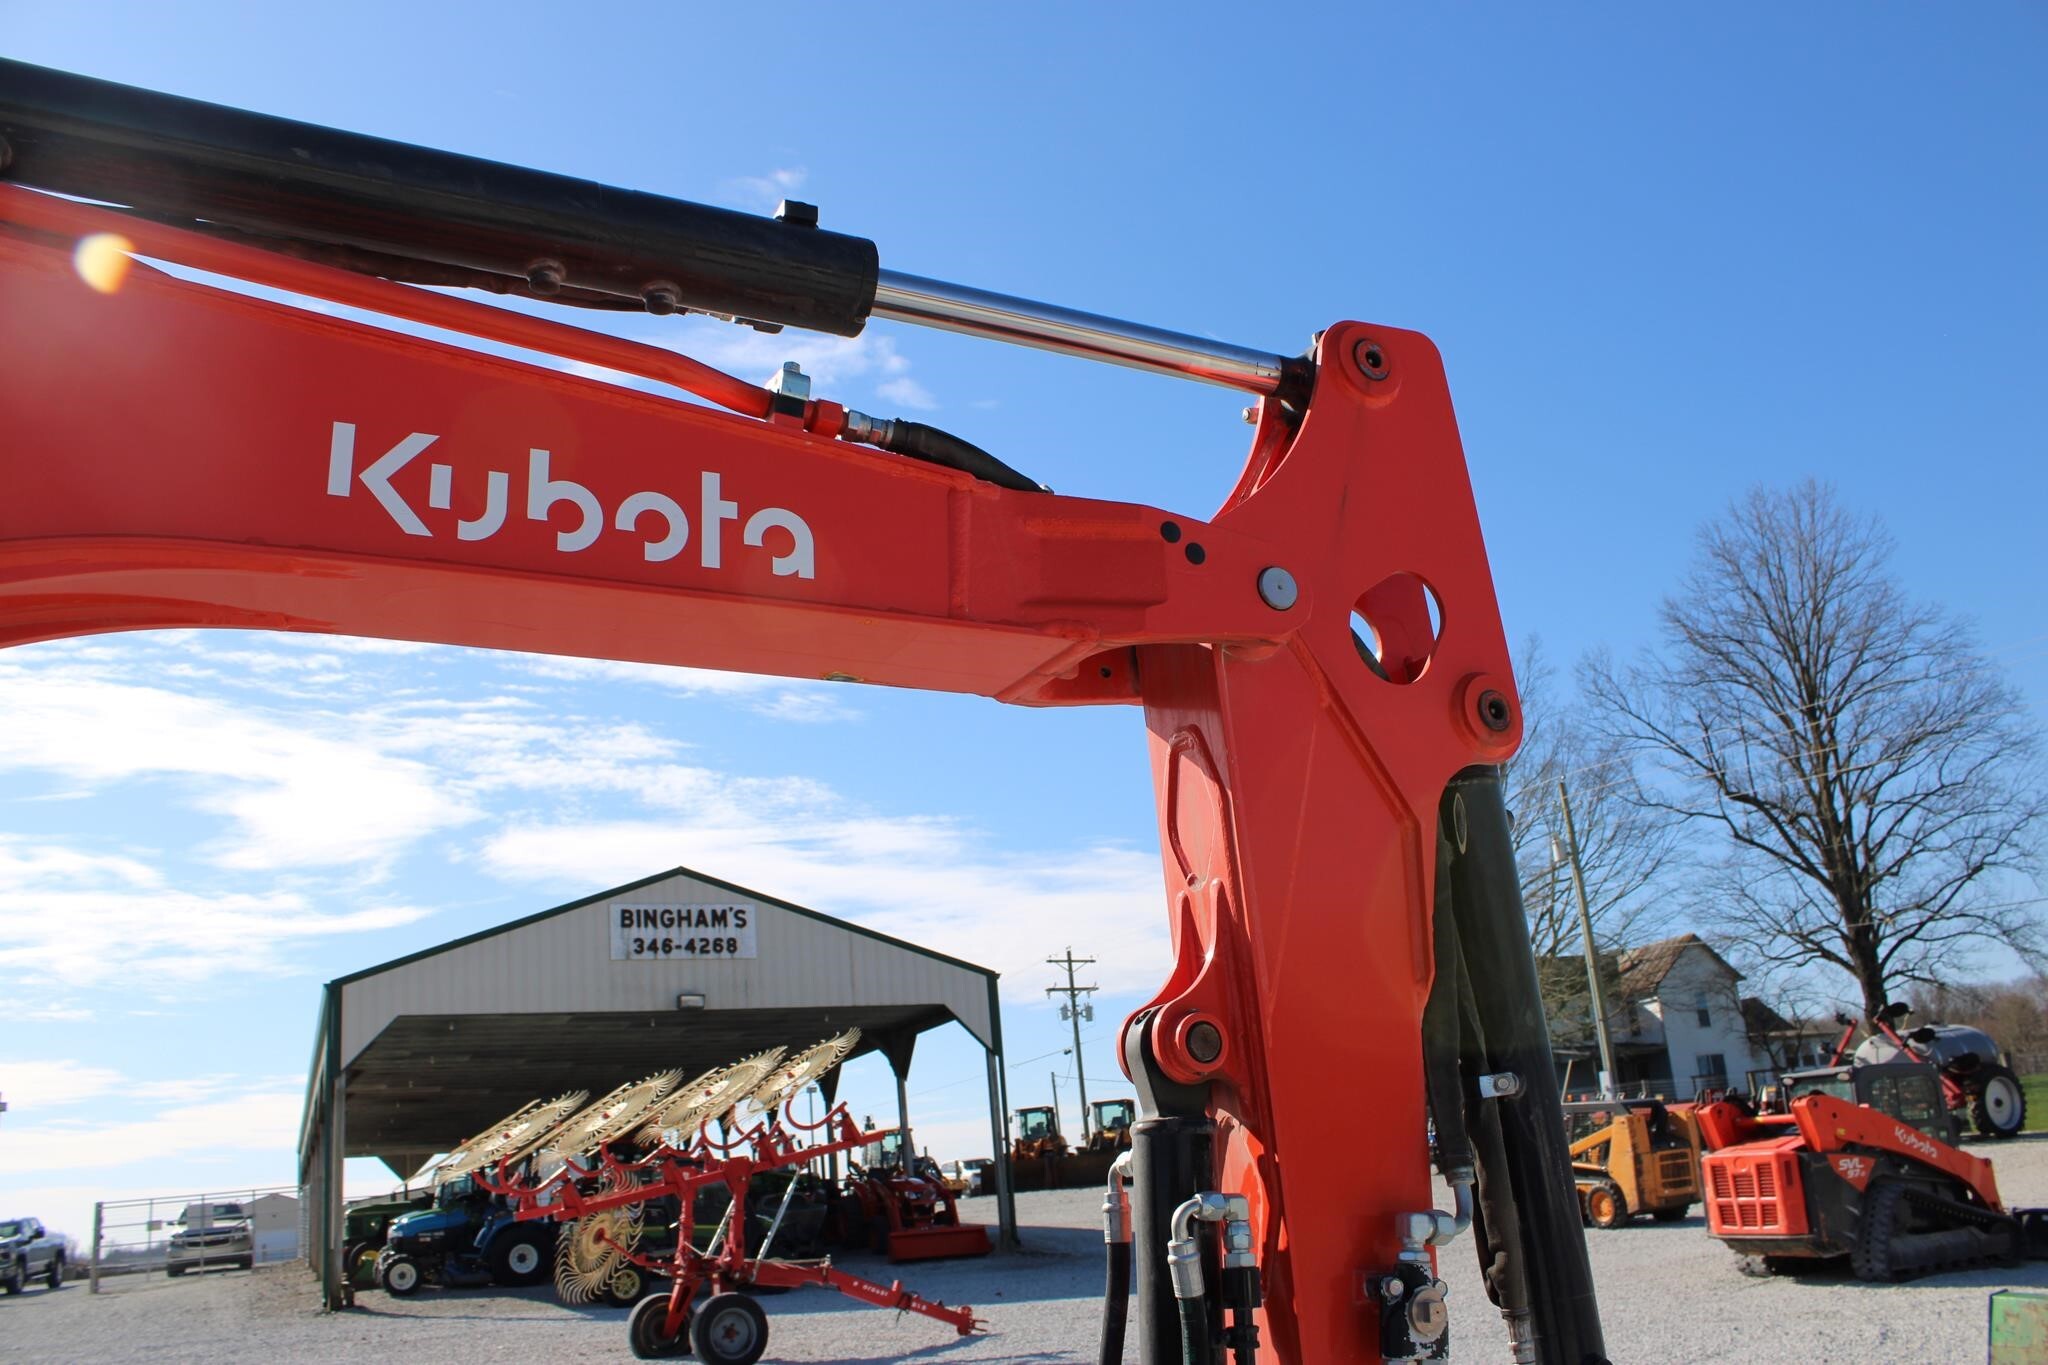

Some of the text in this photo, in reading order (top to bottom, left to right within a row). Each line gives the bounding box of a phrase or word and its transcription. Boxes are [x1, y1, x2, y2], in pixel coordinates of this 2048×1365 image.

[326, 420, 816, 580] Kubota
[620, 907, 748, 929] BINGHAM'S
[633, 937, 738, 955] 346-4268
[1894, 1126, 1938, 1159] Kubota
[1838, 1156, 1865, 1171] SVL
